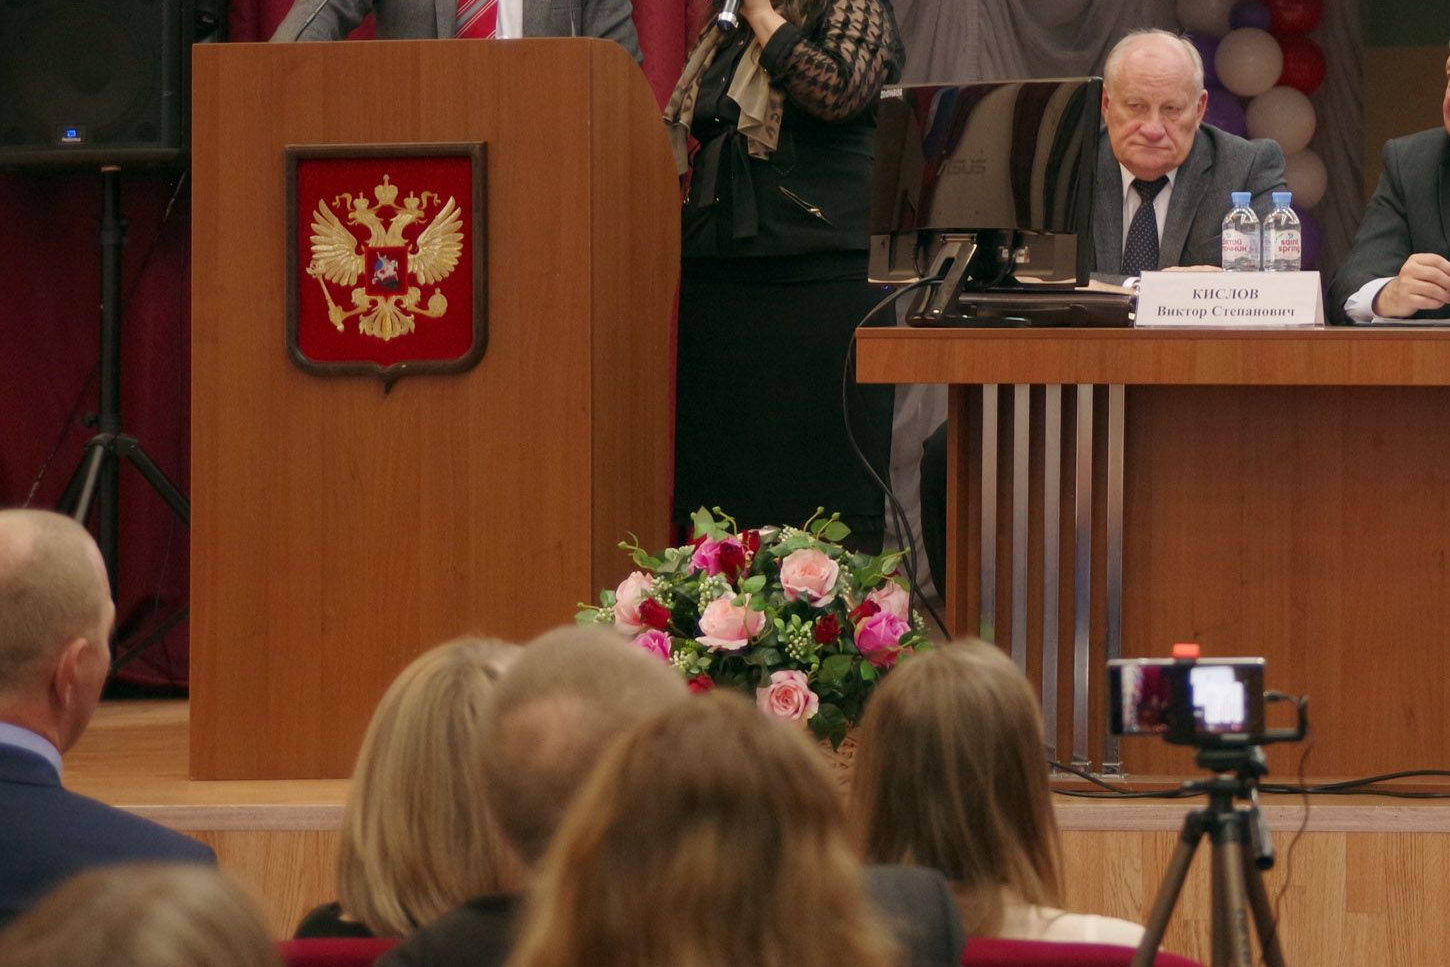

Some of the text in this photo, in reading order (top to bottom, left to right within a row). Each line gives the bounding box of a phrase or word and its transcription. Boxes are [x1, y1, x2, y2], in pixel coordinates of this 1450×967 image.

[1192, 288, 1259, 300] КИСЛОВ
[1157, 305, 1295, 319] Виктор Степанович
